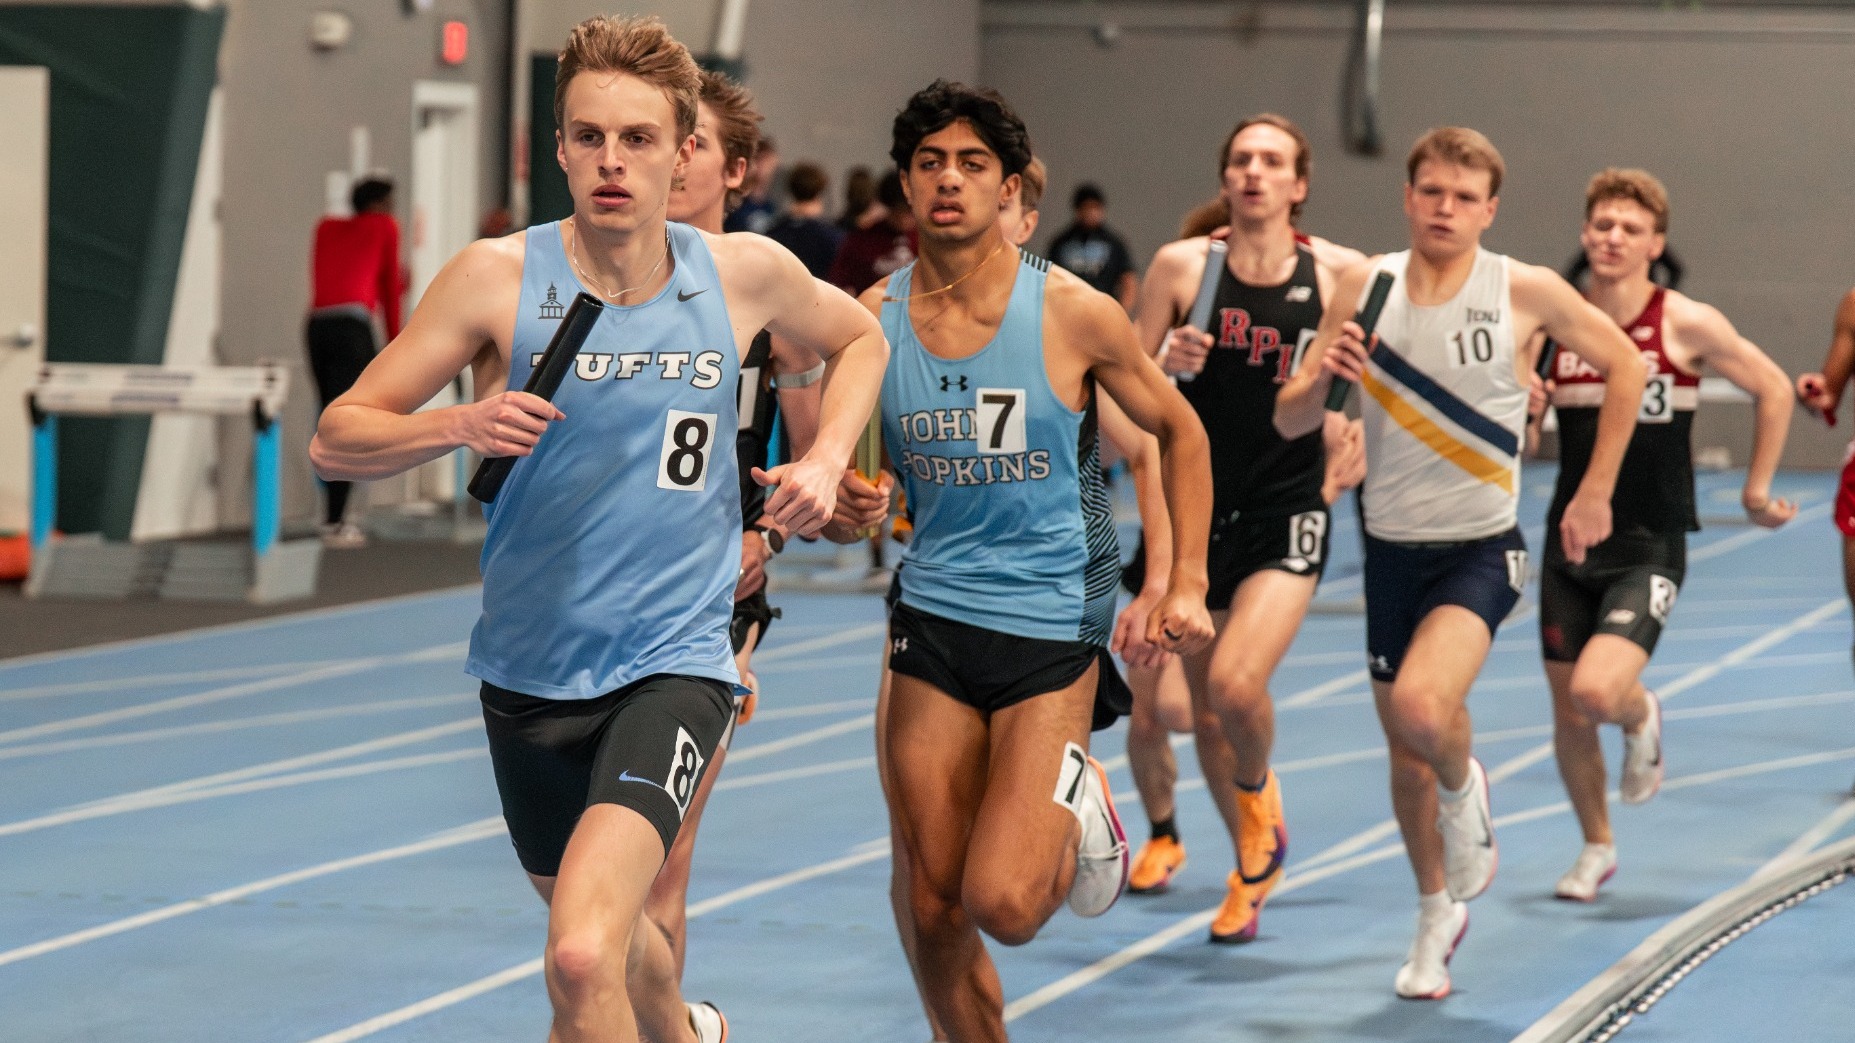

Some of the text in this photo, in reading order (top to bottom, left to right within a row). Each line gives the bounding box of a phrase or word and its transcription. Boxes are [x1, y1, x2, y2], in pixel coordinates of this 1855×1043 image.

[1218, 307, 1296, 385] RPI
[1451, 327, 1494, 365] 10
[982, 394, 1016, 448] 7
[1643, 379, 1666, 416] 3
[667, 417, 709, 487] 8
[1298, 515, 1316, 555] 6
[673, 741, 697, 809] 8
[1065, 748, 1086, 805] 7
